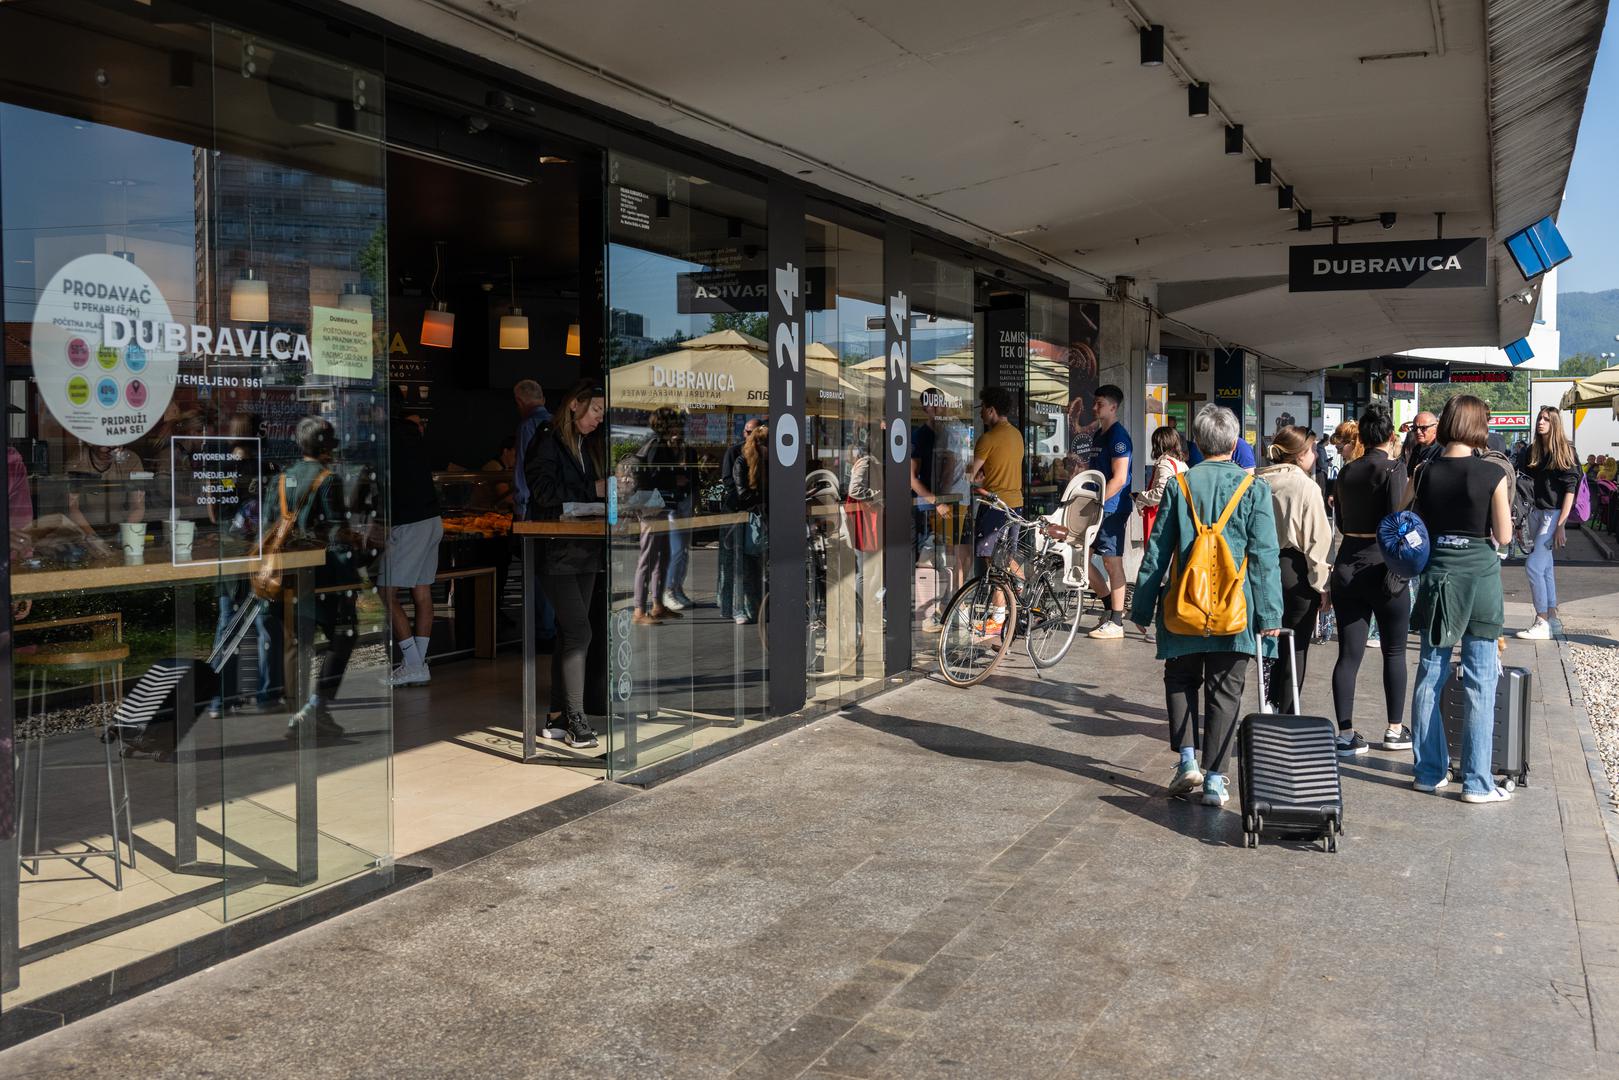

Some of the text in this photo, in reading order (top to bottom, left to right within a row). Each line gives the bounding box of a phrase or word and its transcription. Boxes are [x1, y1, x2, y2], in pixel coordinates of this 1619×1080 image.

[1313, 255, 1462, 275] DUBRAVICA
[63, 278, 151, 304] PRODAVAČ
[73, 302, 79, 311] U
[329, 315, 358, 324] DUBRAVICA
[102, 314, 312, 361] DUBRAVICA
[1000, 346, 1015, 358] TEK
[653, 365, 735, 392] DUBRAVICA
[1407, 368, 1445, 379] mlinar
[169, 374, 263, 388] UTEMELJENO 1961
[1217, 388, 1241, 396] TAXI
[923, 391, 963, 409] DUBRAVICA
[101, 412, 147, 426] PRIDRUŽI
[106, 425, 144, 436] NAM SE!
[193, 453, 225, 461] OTVORENI
[193, 471, 238, 479] PONEDJELJAK
[202, 485, 234, 493] NEDJELJA
[197, 496, 216, 505] 00:00
[221, 496, 239, 504] 24:00
